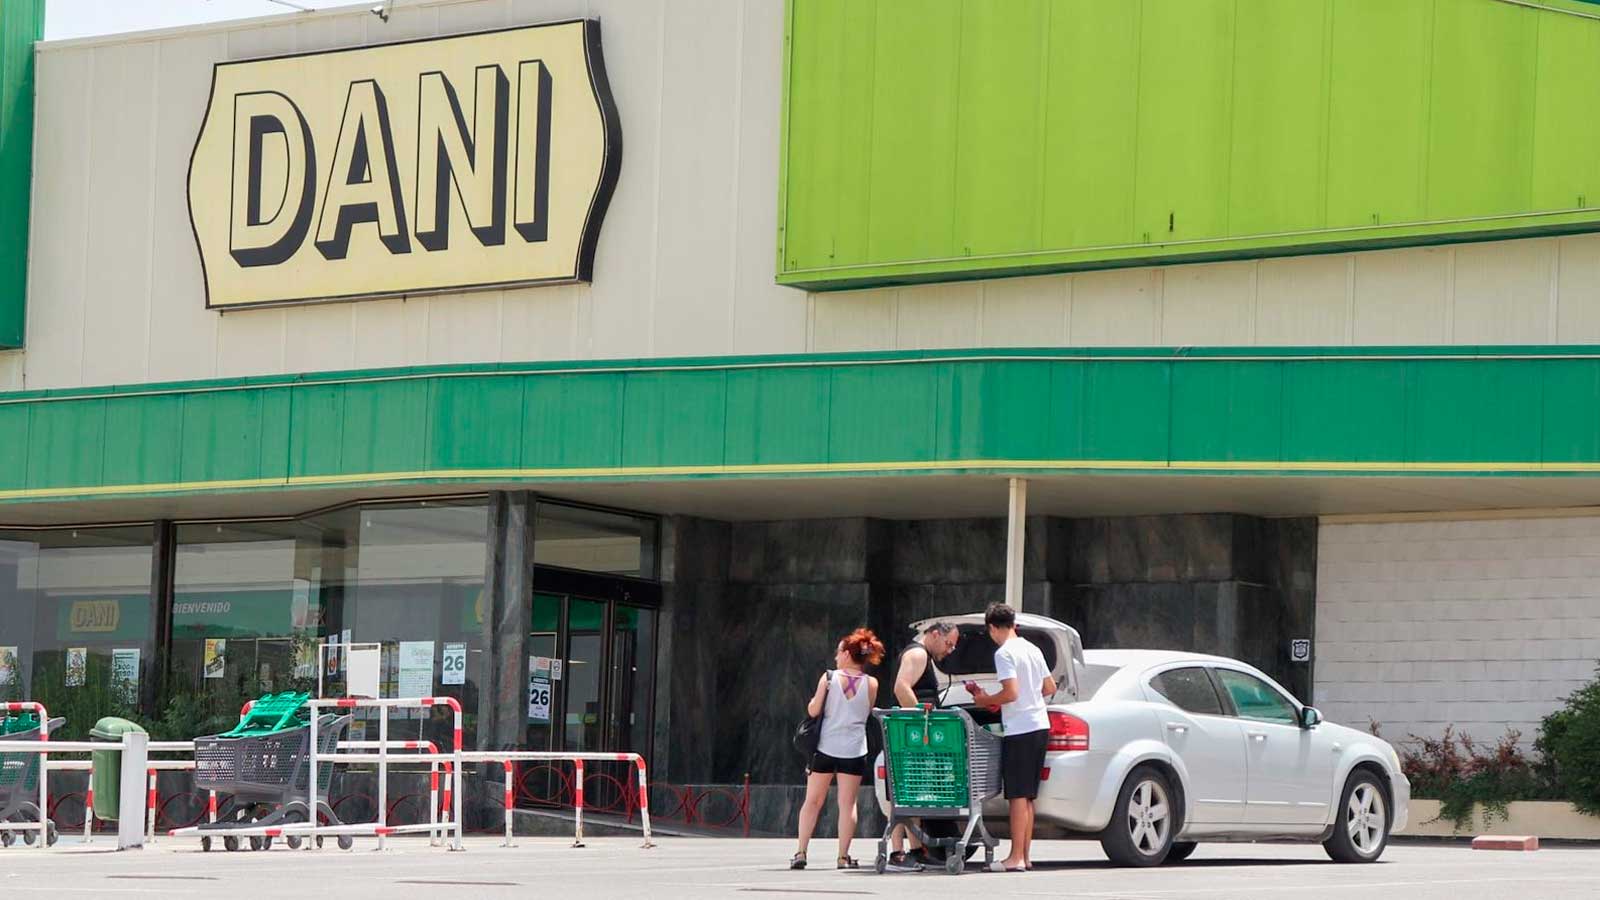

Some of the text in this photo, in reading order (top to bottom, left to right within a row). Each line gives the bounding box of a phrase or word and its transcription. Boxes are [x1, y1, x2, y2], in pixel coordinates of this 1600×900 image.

[230, 59, 553, 268] DANI
[74, 603, 116, 627] DANI
[172, 601, 231, 615] BIENVENIDO
[444, 655, 465, 671] 26
[530, 688, 549, 706] 26
